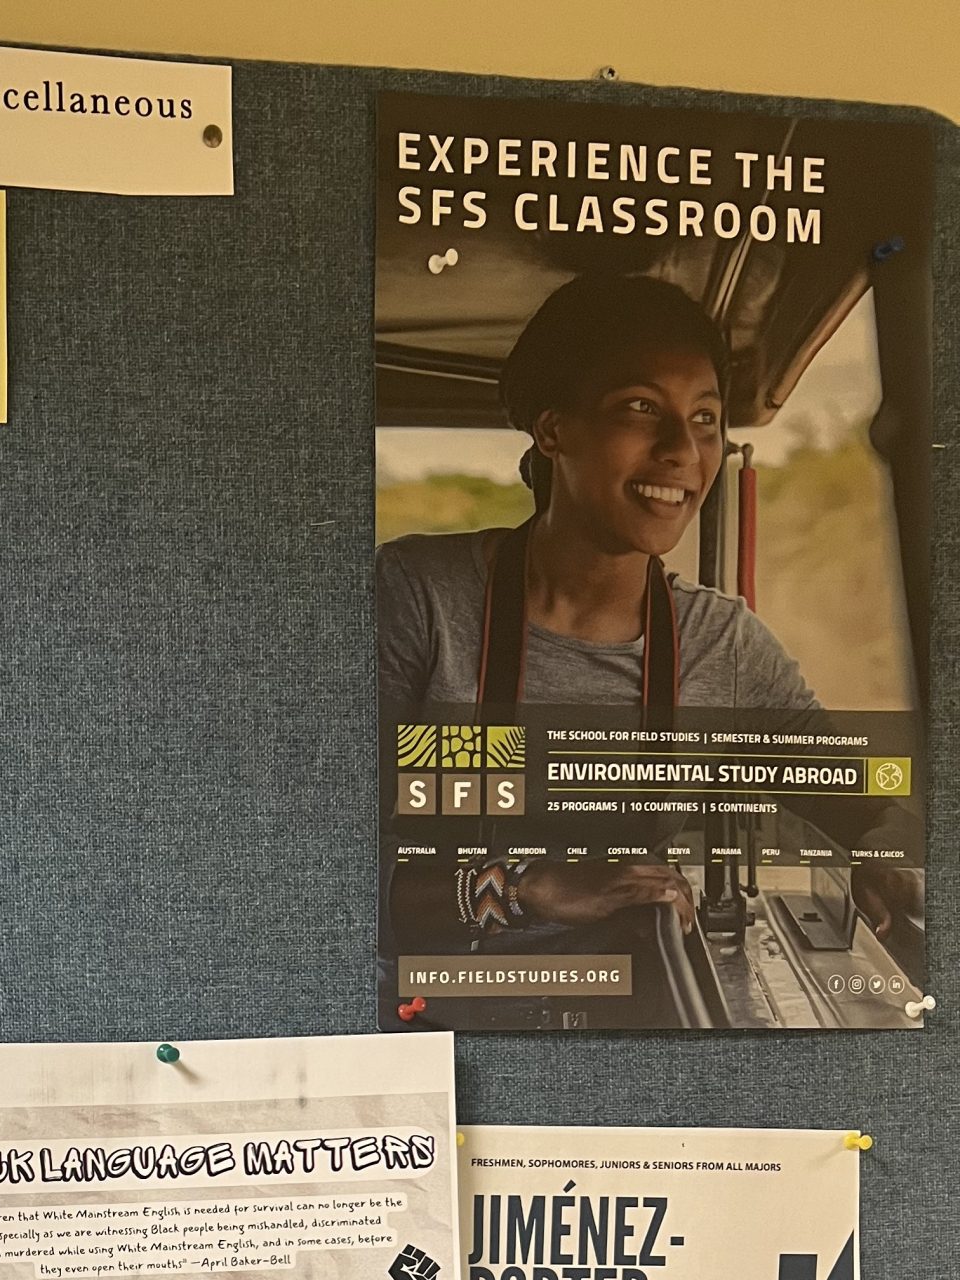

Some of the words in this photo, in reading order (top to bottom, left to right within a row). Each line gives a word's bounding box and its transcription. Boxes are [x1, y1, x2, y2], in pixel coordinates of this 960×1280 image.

[399, 133, 711, 185] EXPERIENCE
[735, 152, 824, 193] THE
[399, 186, 486, 228] SFS
[515, 193, 820, 244] CLASSROOM
[547, 730, 567, 740] THE
[568, 730, 608, 740] SCHOOL
[609, 731, 629, 740] FOR
[631, 731, 658, 741] FIELD
[659, 732, 700, 742] STUDIES
[711, 733, 761, 743] SEMESTER
[762, 734, 770, 744] &
[772, 734, 814, 744] SUMMER
[816, 736, 868, 746] PROGRAMS
[548, 763, 714, 782] ENVIRONMENTAL
[718, 765, 778, 783] STUDY
[782, 767, 857, 785] ABROAD
[547, 801, 560, 811] 25
[562, 801, 618, 811] PROGRAMS
[630, 802, 642, 811] 10
[644, 802, 698, 812] COUNTRIES
[710, 803, 716, 812] 5
[718, 803, 777, 813] CONTINENTS
[410, 970, 619, 984] INFO.FIELDSTUDIES.ORG
[40, 1143, 236, 1182] LANGUAGE
[243, 1135, 436, 1176] MATTERS
[471, 1158, 526, 1168] FRESHMEN,
[528, 1159, 598, 1169] SOPHOMORES,
[599, 1160, 641, 1169] JUNIORS
[643, 1161, 650, 1169] &
[652, 1161, 694, 1170] SENIORS
[696, 1162, 724, 1171] FROM
[725, 1162, 743, 1171] ALL
[745, 1163, 781, 1171] MAJORS
[468, 1179, 684, 1266] JIMÉNEZ-
